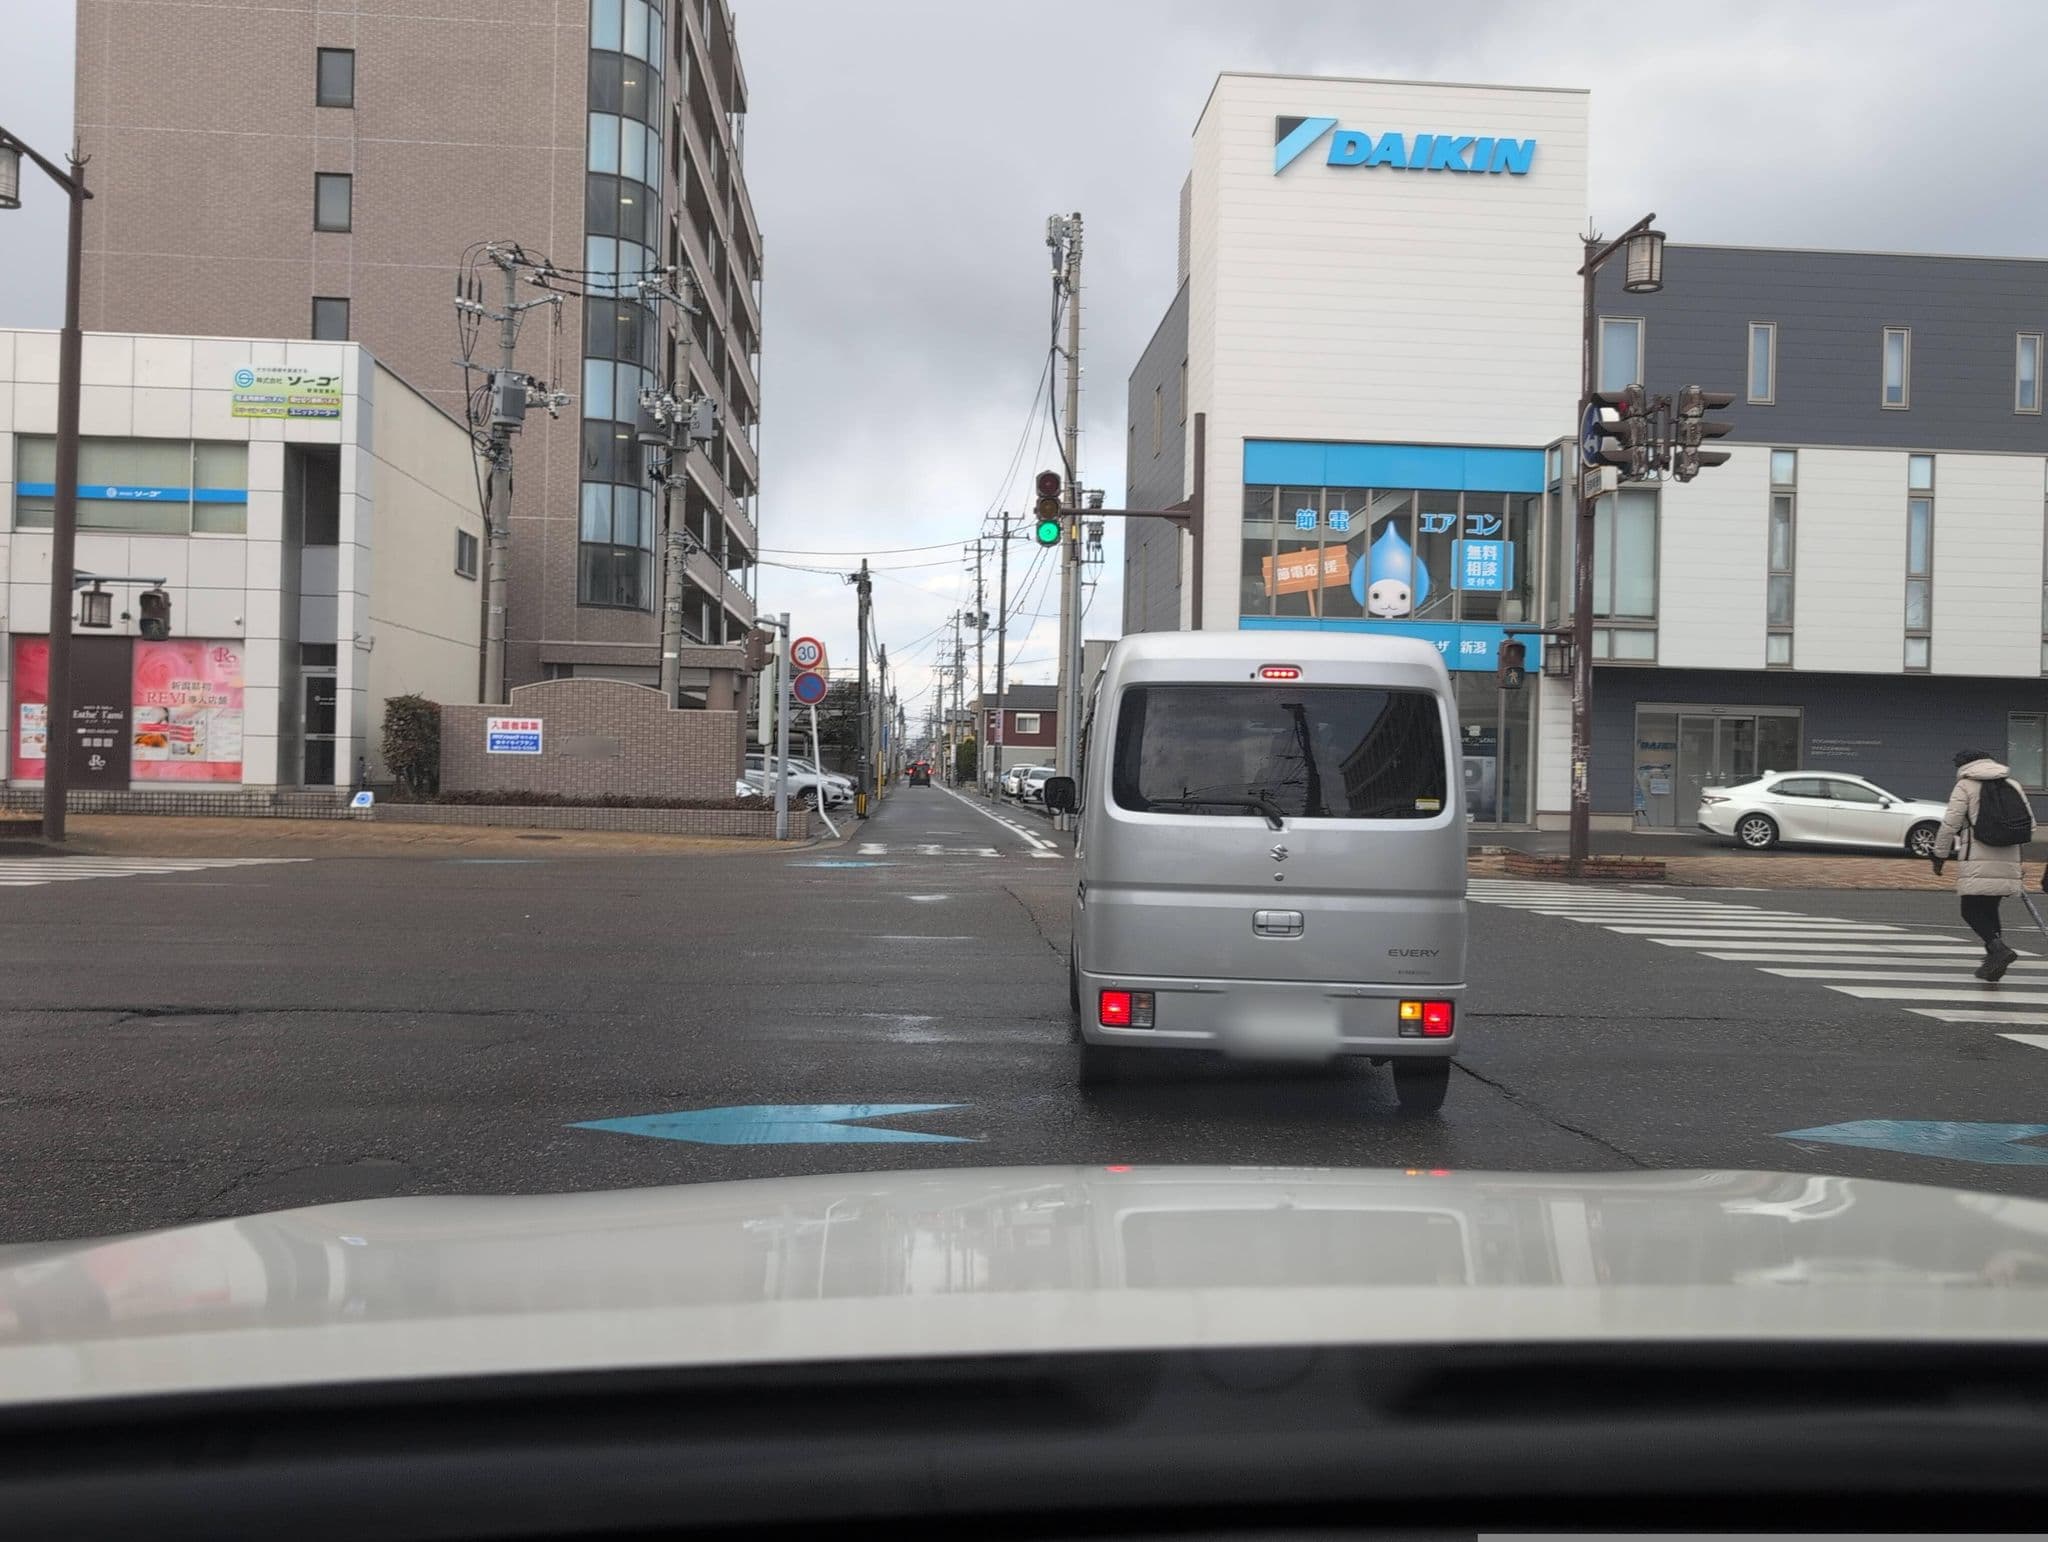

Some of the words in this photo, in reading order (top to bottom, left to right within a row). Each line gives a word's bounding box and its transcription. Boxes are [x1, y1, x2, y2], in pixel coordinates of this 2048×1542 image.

[1326, 130, 1536, 175] DAIKIN
[1295, 508, 1350, 532] 節電
[1419, 513, 1502, 536] エアコン
[1466, 545, 1498, 561] 無料
[1276, 559, 1338, 581] 節電応援
[1466, 561, 1498, 577] 相談
[1466, 577, 1496, 587] 受付中
[798, 645, 817, 661] 30
[1460, 640, 1488, 656] 新潟
[147, 691, 187, 704] REVI
[1388, 948, 1440, 958] EVERY
